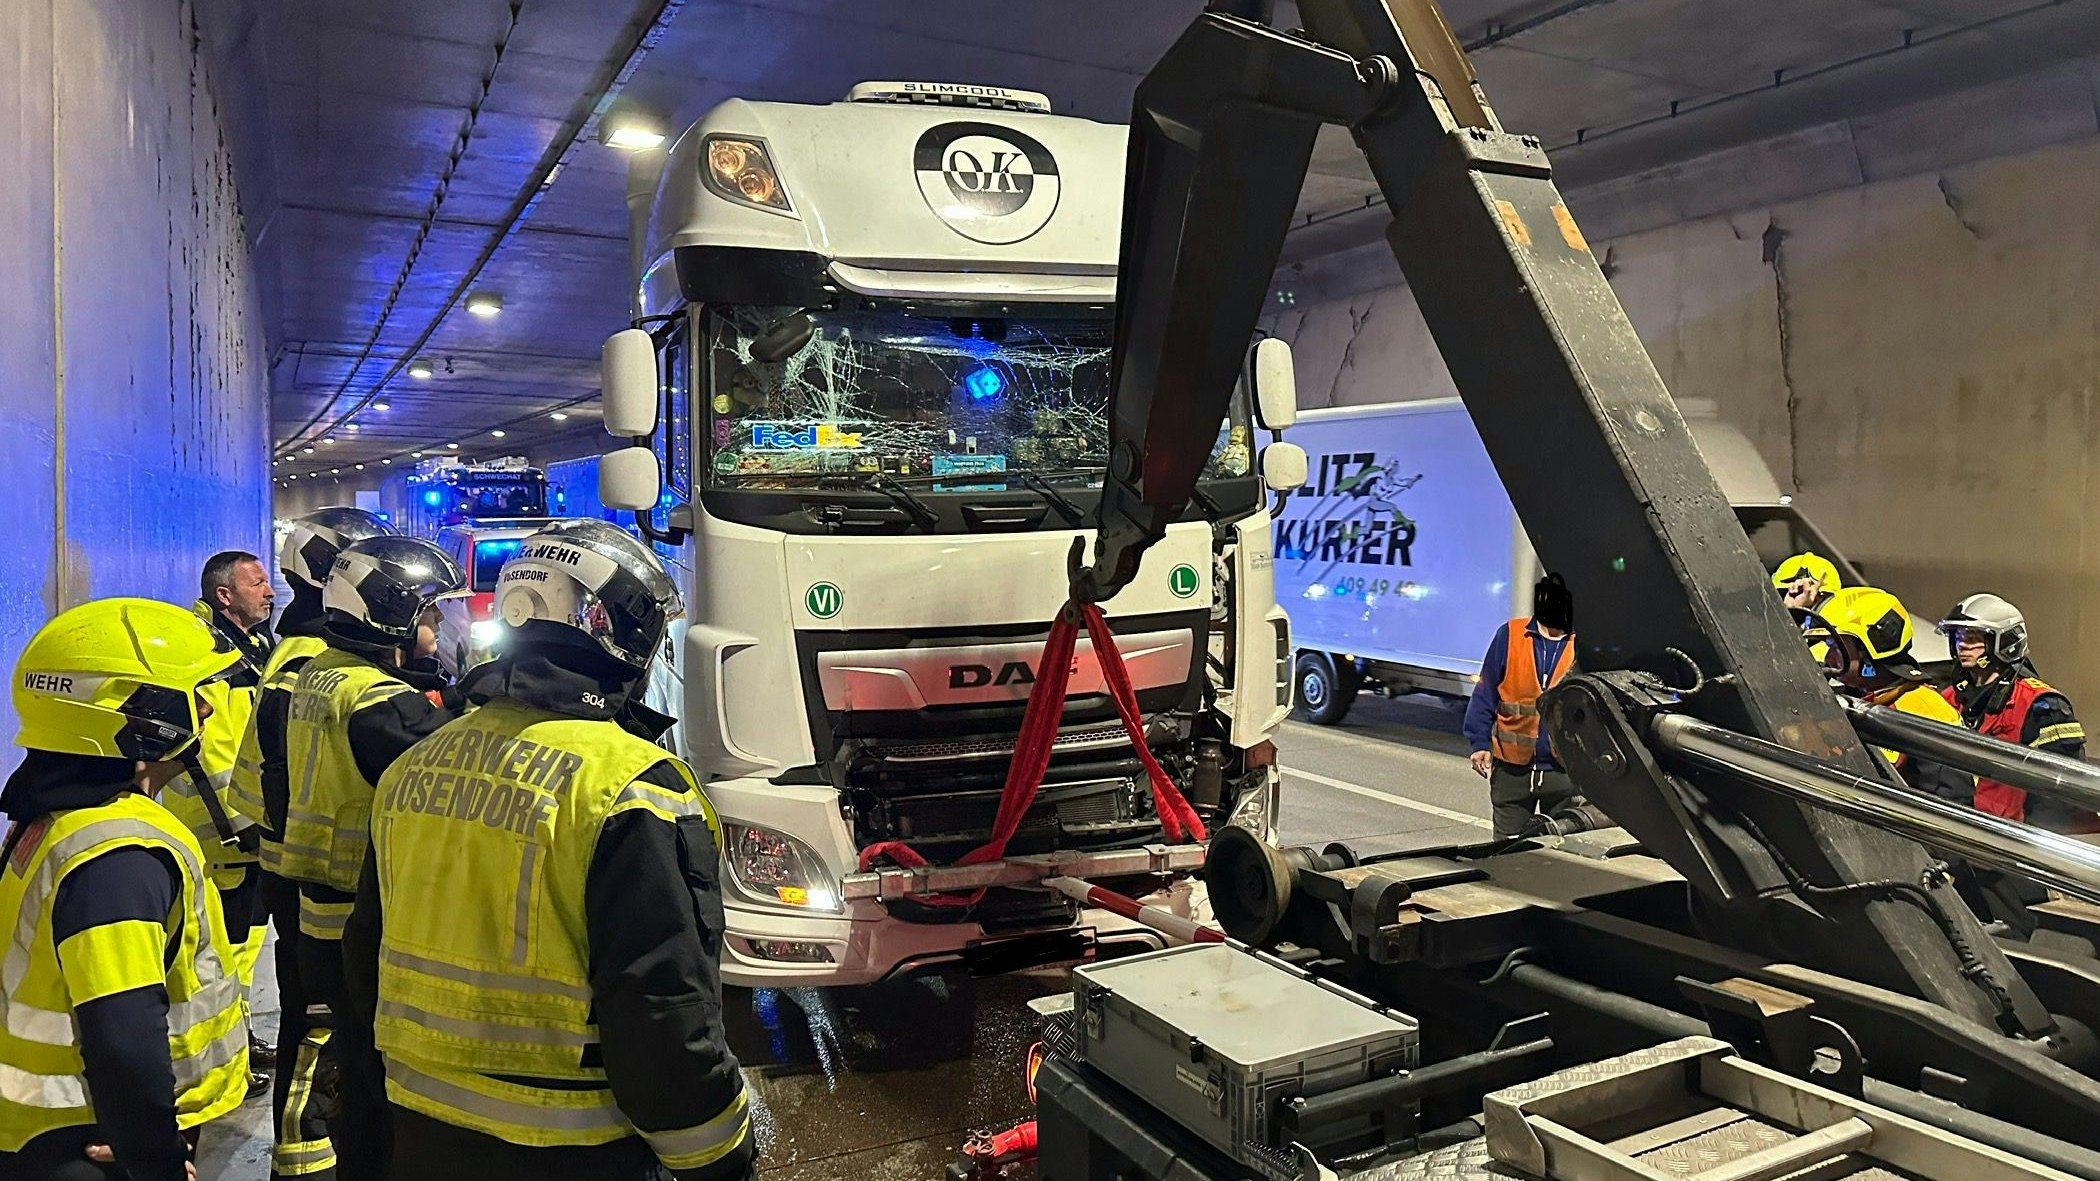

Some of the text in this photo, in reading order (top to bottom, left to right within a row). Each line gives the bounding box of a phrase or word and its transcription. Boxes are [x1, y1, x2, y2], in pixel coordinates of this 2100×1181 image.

[904, 83, 1012, 98] SLIMCOOL
[752, 425, 864, 448] FedEx
[1275, 453, 1378, 497] LITZ
[1274, 519, 1416, 567] KURIER
[1176, 571, 1192, 592] L
[814, 588, 836, 612] VI
[25, 672, 74, 694] WEHR
[582, 691, 605, 709] 304
